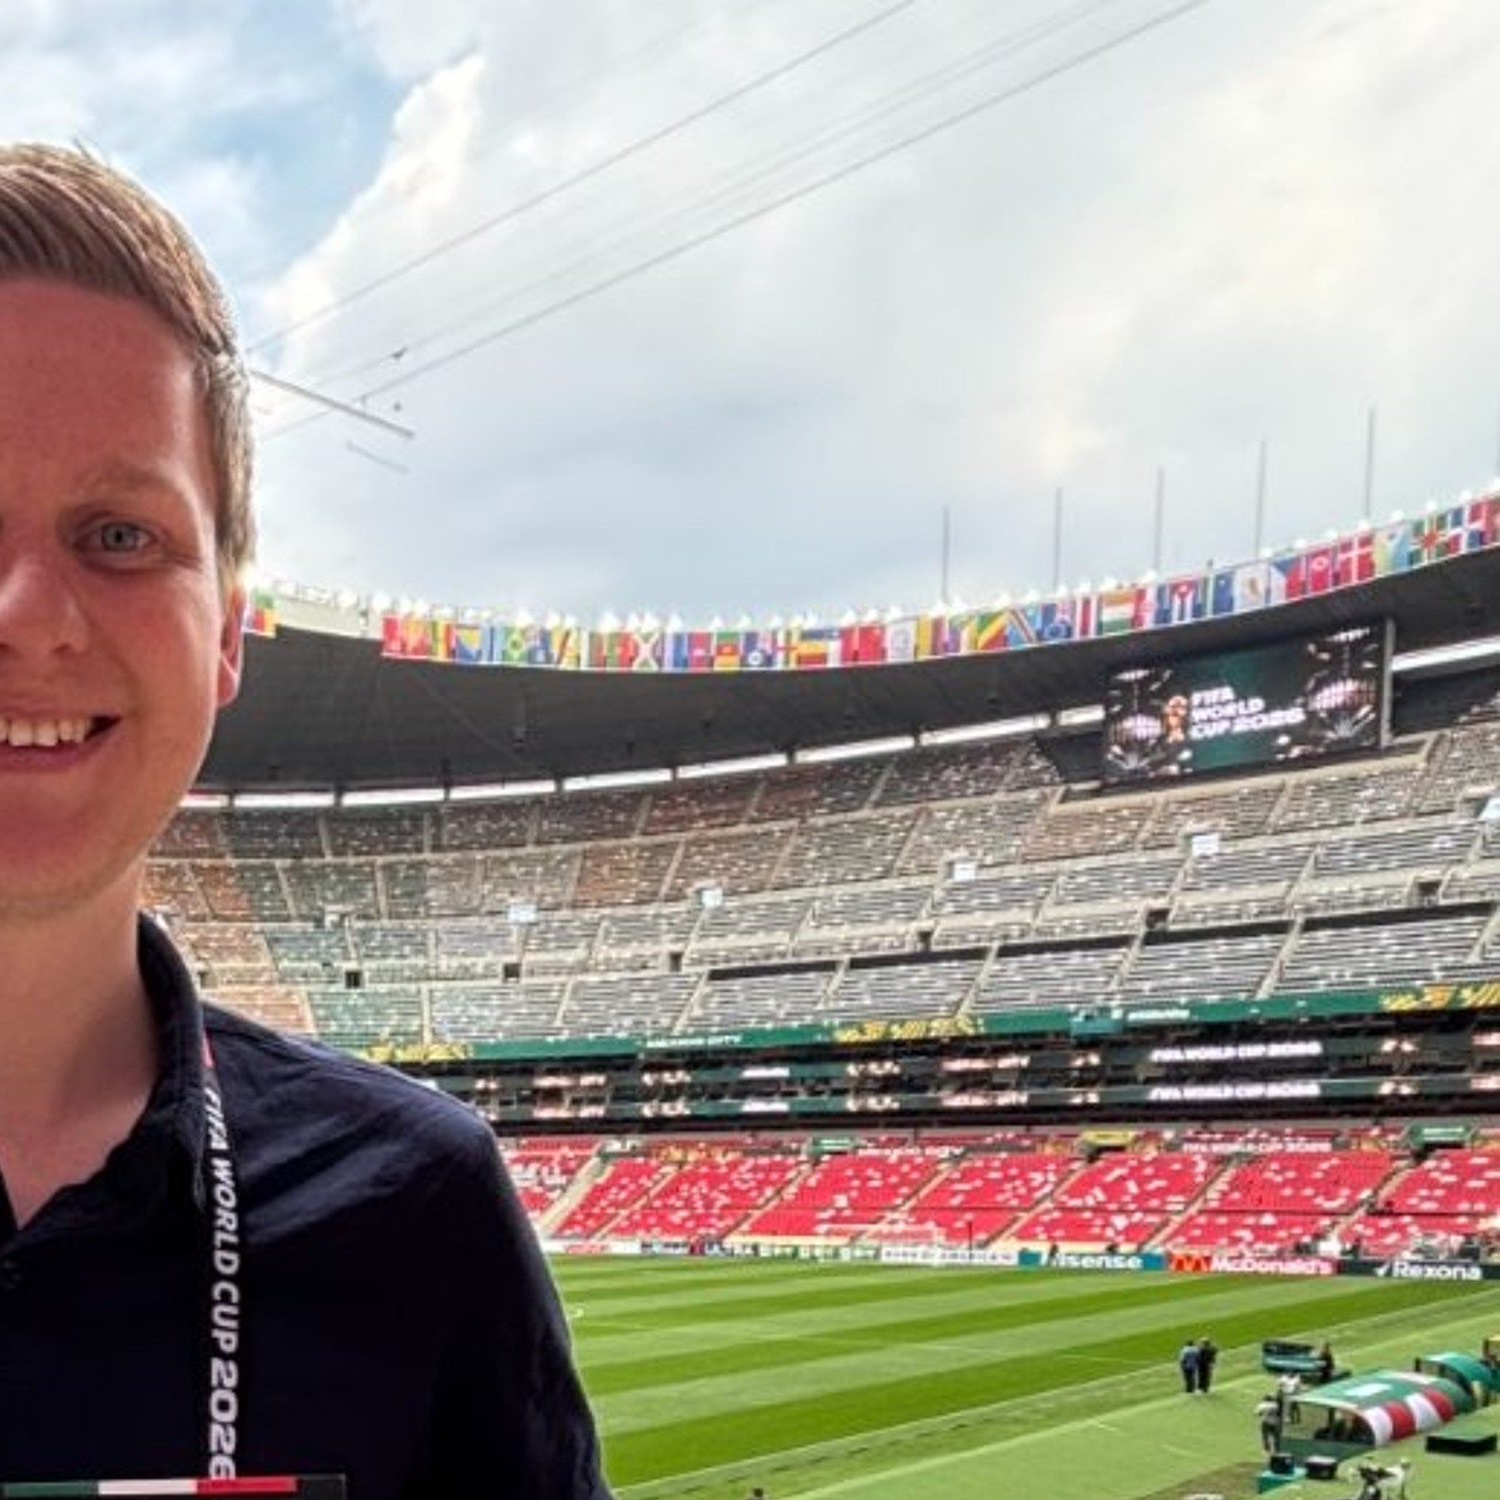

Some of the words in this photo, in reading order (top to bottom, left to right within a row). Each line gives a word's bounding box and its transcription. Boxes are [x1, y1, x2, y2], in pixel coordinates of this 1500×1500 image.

[1191, 686, 1235, 707] FIFA
[1191, 698, 1265, 721] WORLD
[1190, 719, 1231, 739] CUP
[204, 1087, 228, 1150] FIFA
[211, 1157, 239, 1275] WORLD
[1393, 1261, 1483, 1280] Rexona
[211, 1281, 240, 1353] CUP
[209, 1357, 238, 1480] 2026
